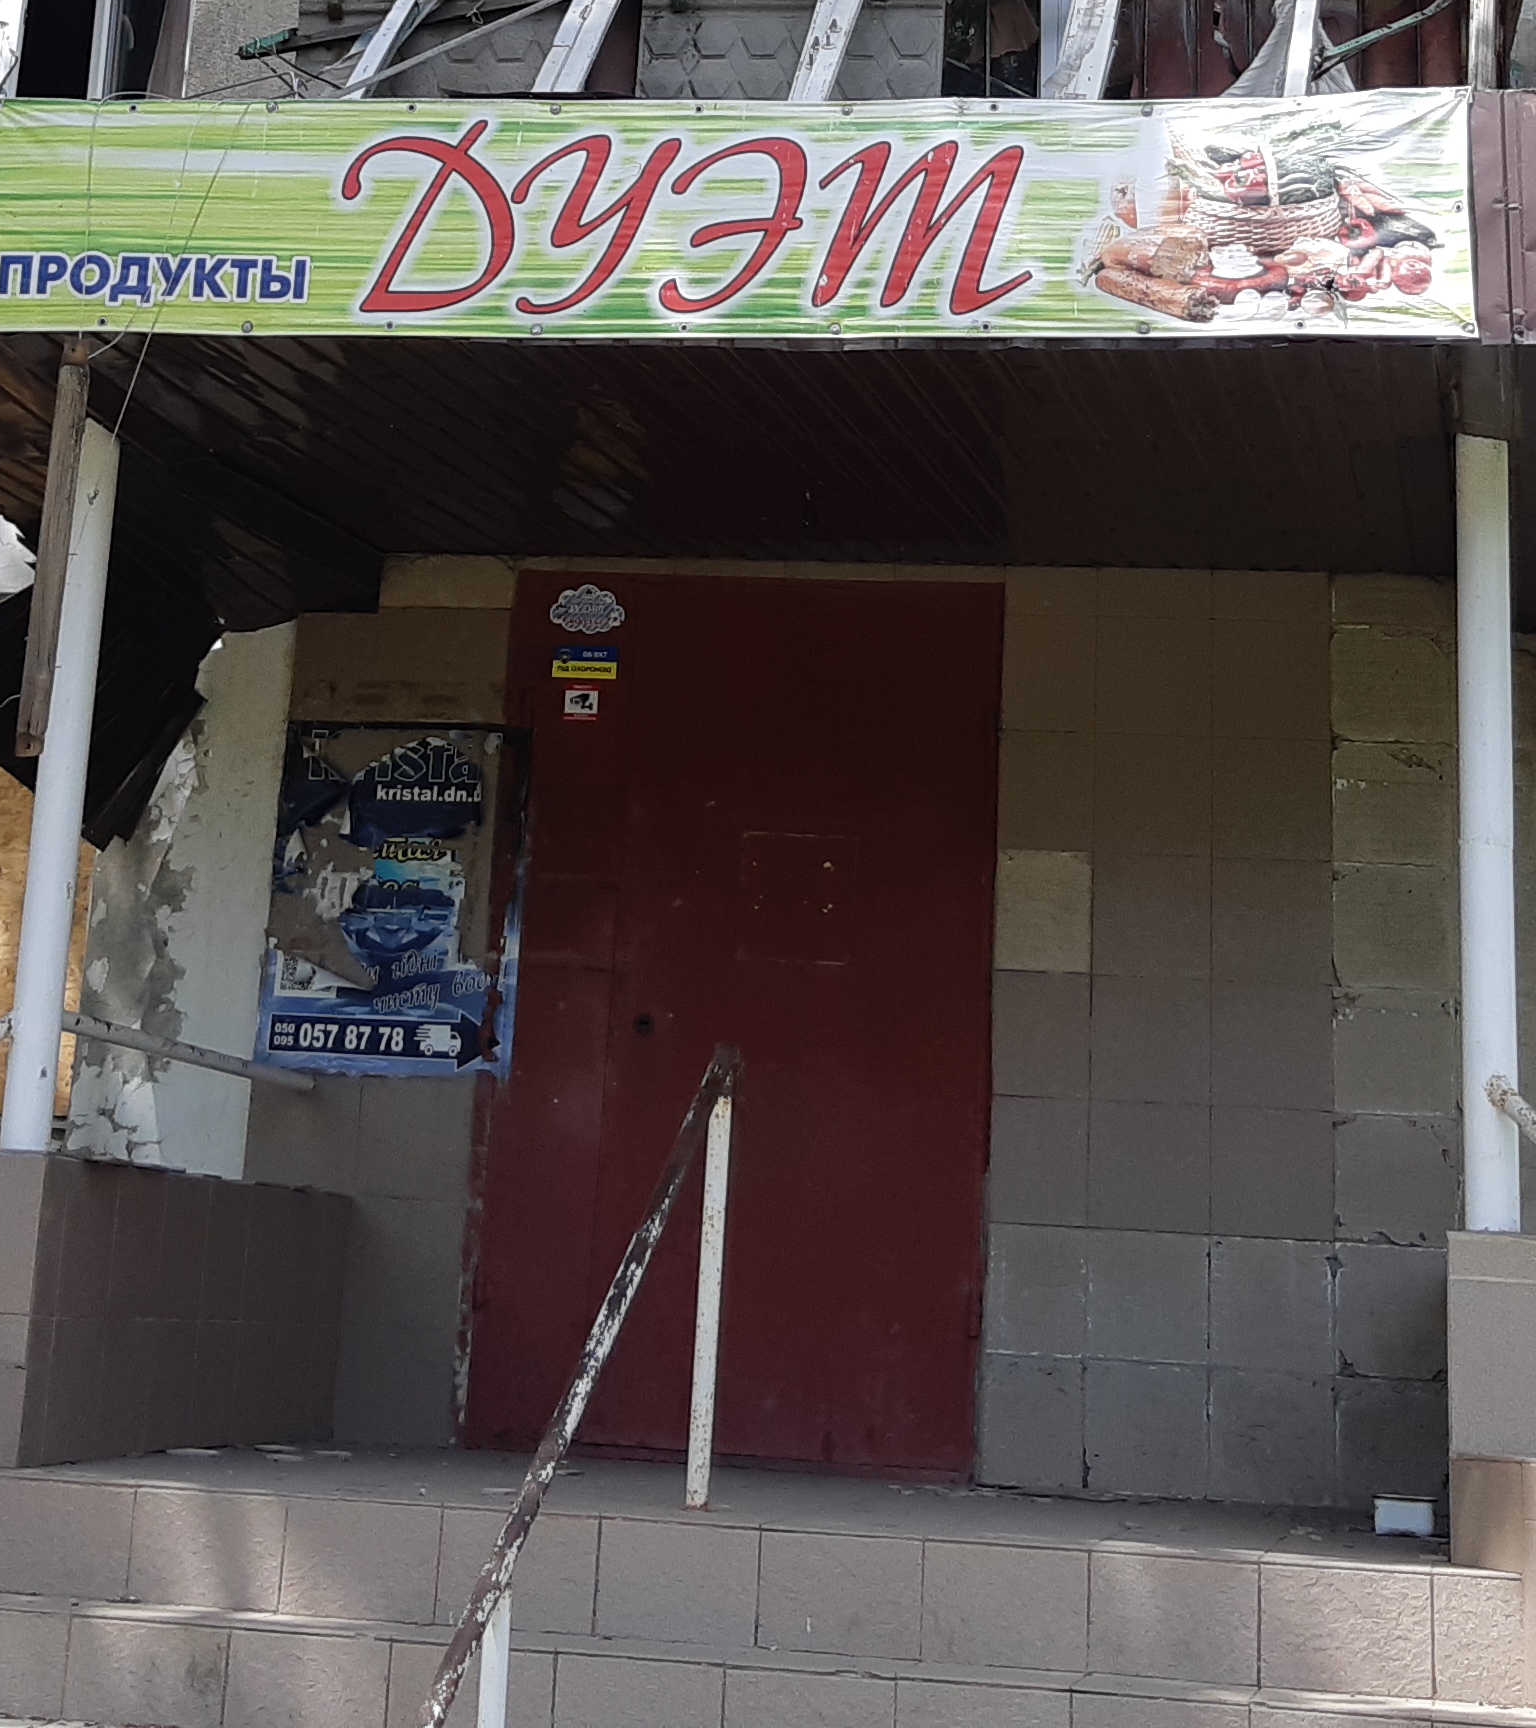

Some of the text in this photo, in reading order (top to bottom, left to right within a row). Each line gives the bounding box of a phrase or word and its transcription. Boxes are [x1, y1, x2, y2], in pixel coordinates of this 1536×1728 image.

[341, 118, 1034, 315] ДУЭТ
[274, 1022, 296, 1034] 050
[298, 1022, 404, 1052] 057 87 78
[273, 1034, 295, 1046] 095
